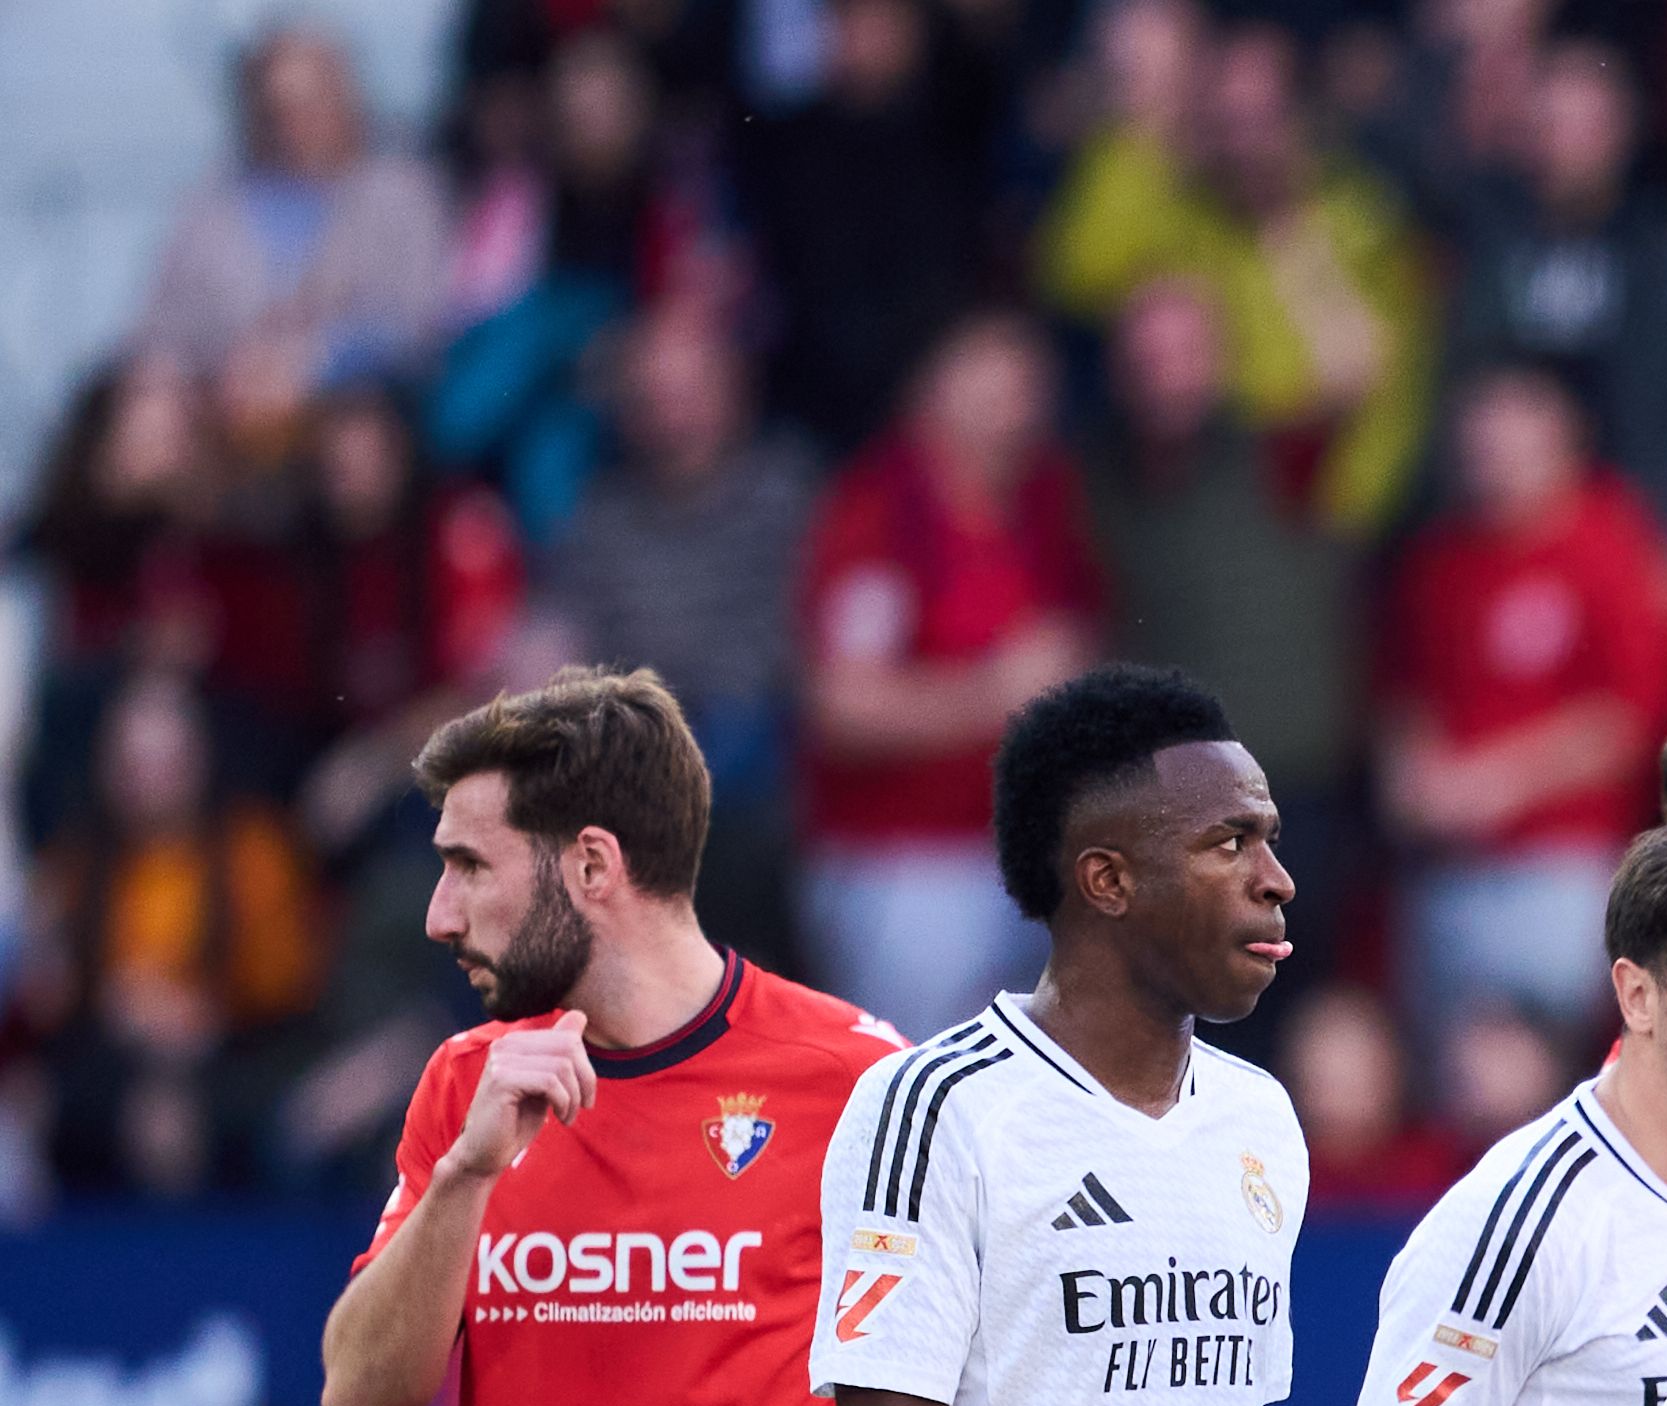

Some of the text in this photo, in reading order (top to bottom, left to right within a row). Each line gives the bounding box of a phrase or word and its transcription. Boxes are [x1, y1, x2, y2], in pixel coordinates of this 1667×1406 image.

[533, 1299, 757, 1323] Climatización eficiente
[1104, 1334, 1254, 1393] FLY BETTE
